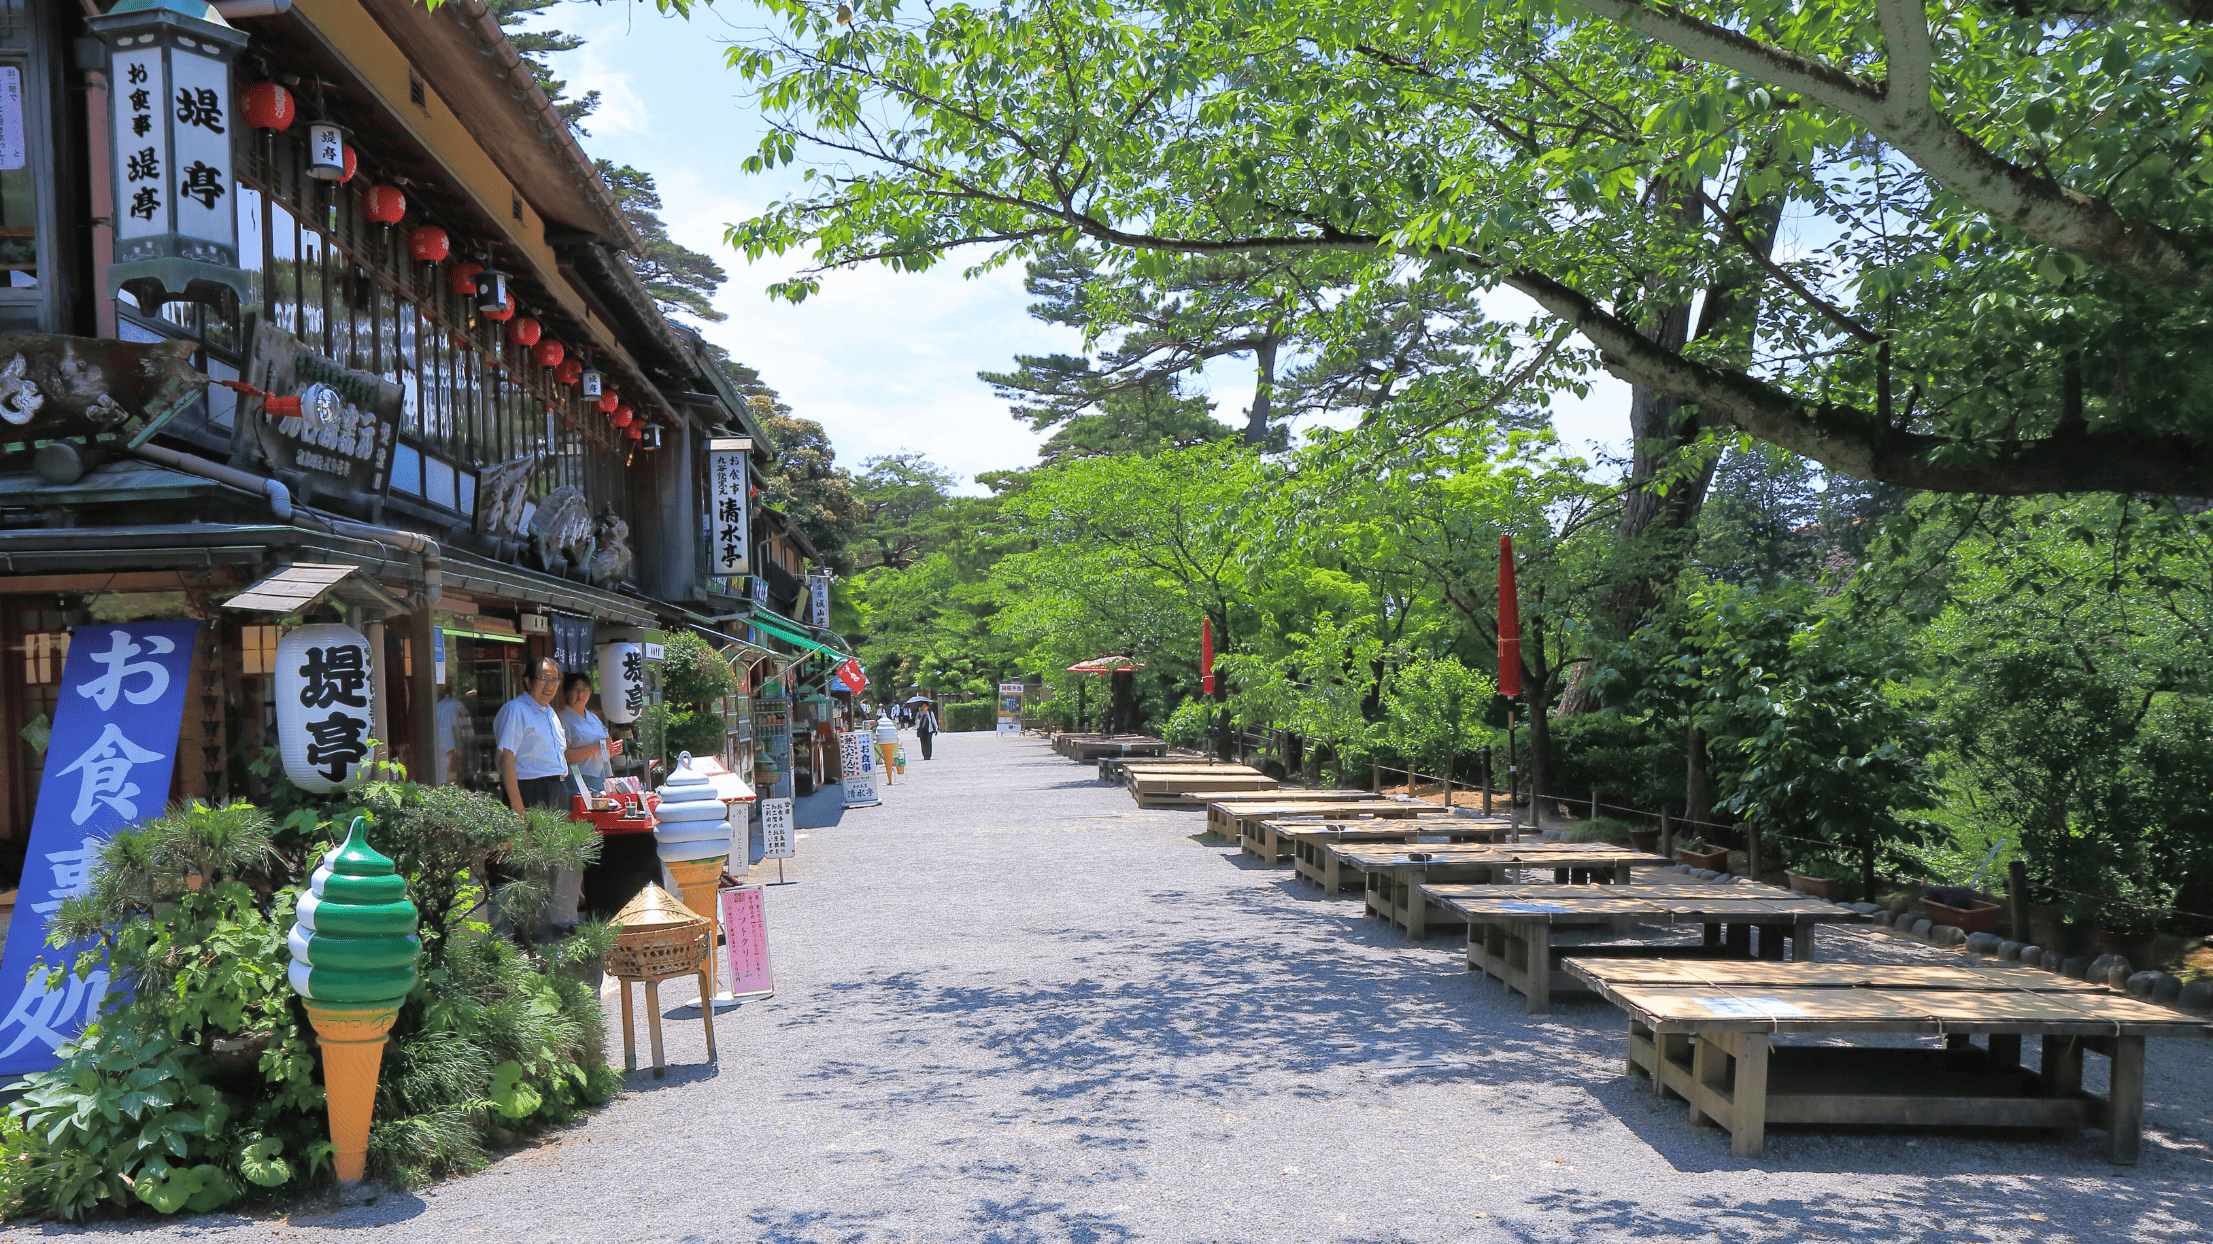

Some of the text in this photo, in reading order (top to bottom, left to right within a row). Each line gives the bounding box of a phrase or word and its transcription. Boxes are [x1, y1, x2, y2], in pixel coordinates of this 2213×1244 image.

[127, 62, 162, 222] お食事 堤亭
[176, 86, 226, 210] 堤亭
[320, 130, 337, 162] 堤亭
[729, 455, 740, 495] お食事
[718, 497, 743, 569] 清水亭
[299, 645, 369, 783] 堤亭
[622, 651, 644, 717] 堤亭
[847, 787, 874, 799] 清水亭
[860, 744, 871, 773] お食事
[737, 906, 753, 978] ソフトクリーム
